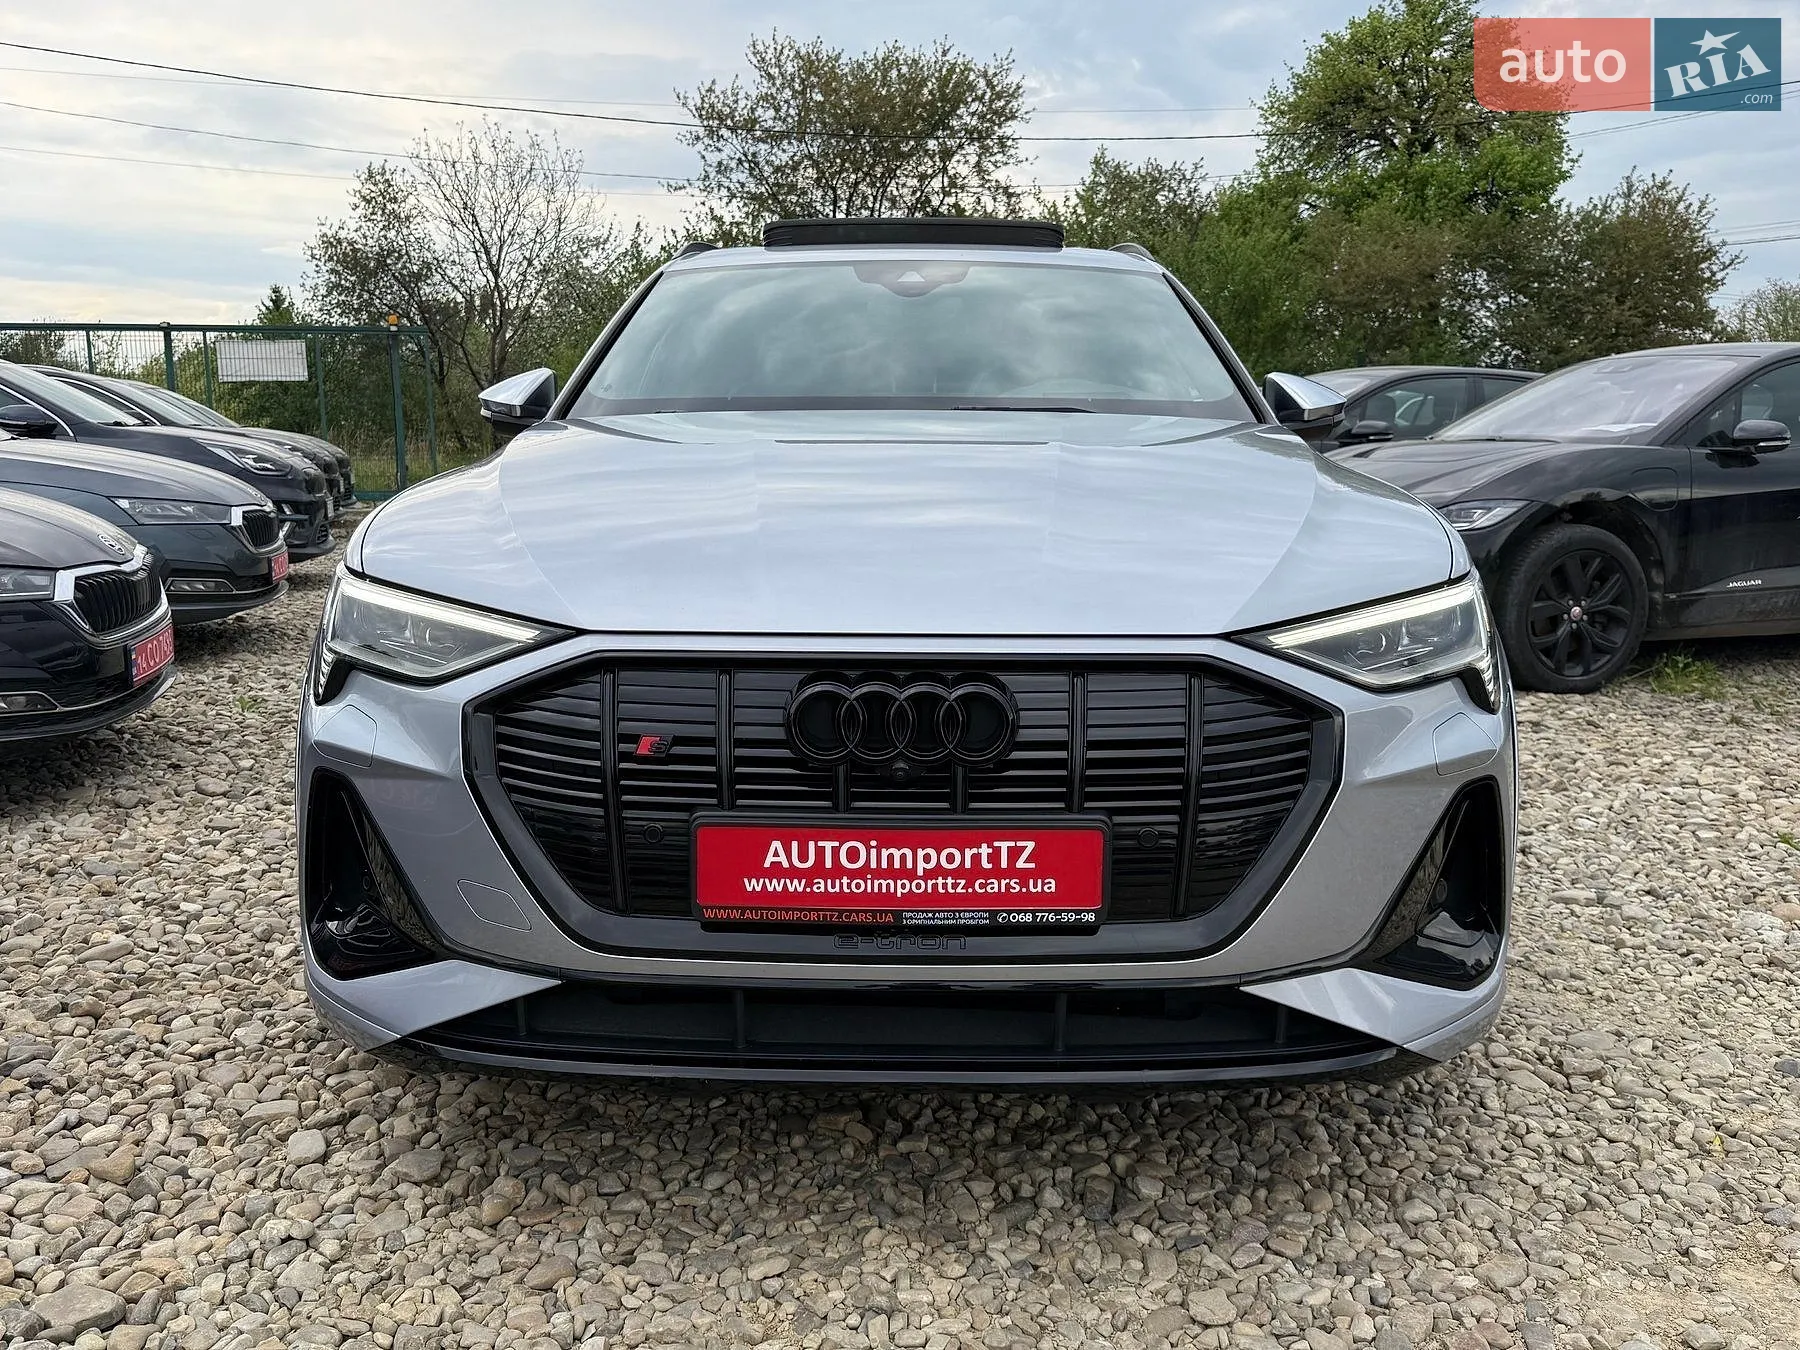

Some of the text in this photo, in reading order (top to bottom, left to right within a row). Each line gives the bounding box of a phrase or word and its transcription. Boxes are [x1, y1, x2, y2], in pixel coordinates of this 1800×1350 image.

[1726, 579, 1762, 588] JAGUAR
[763, 839, 1036, 876] AUTOimportTZ
[743, 874, 1057, 899] www.autoimporttz.cars.ua
[703, 908, 894, 923] WWW.AUTOIMPORTTZ.CARS.UA
[934, 911, 954, 919] АВТО
[1009, 912, 1096, 923] 068 776-59-98
[833, 933, 967, 950] e-tron
